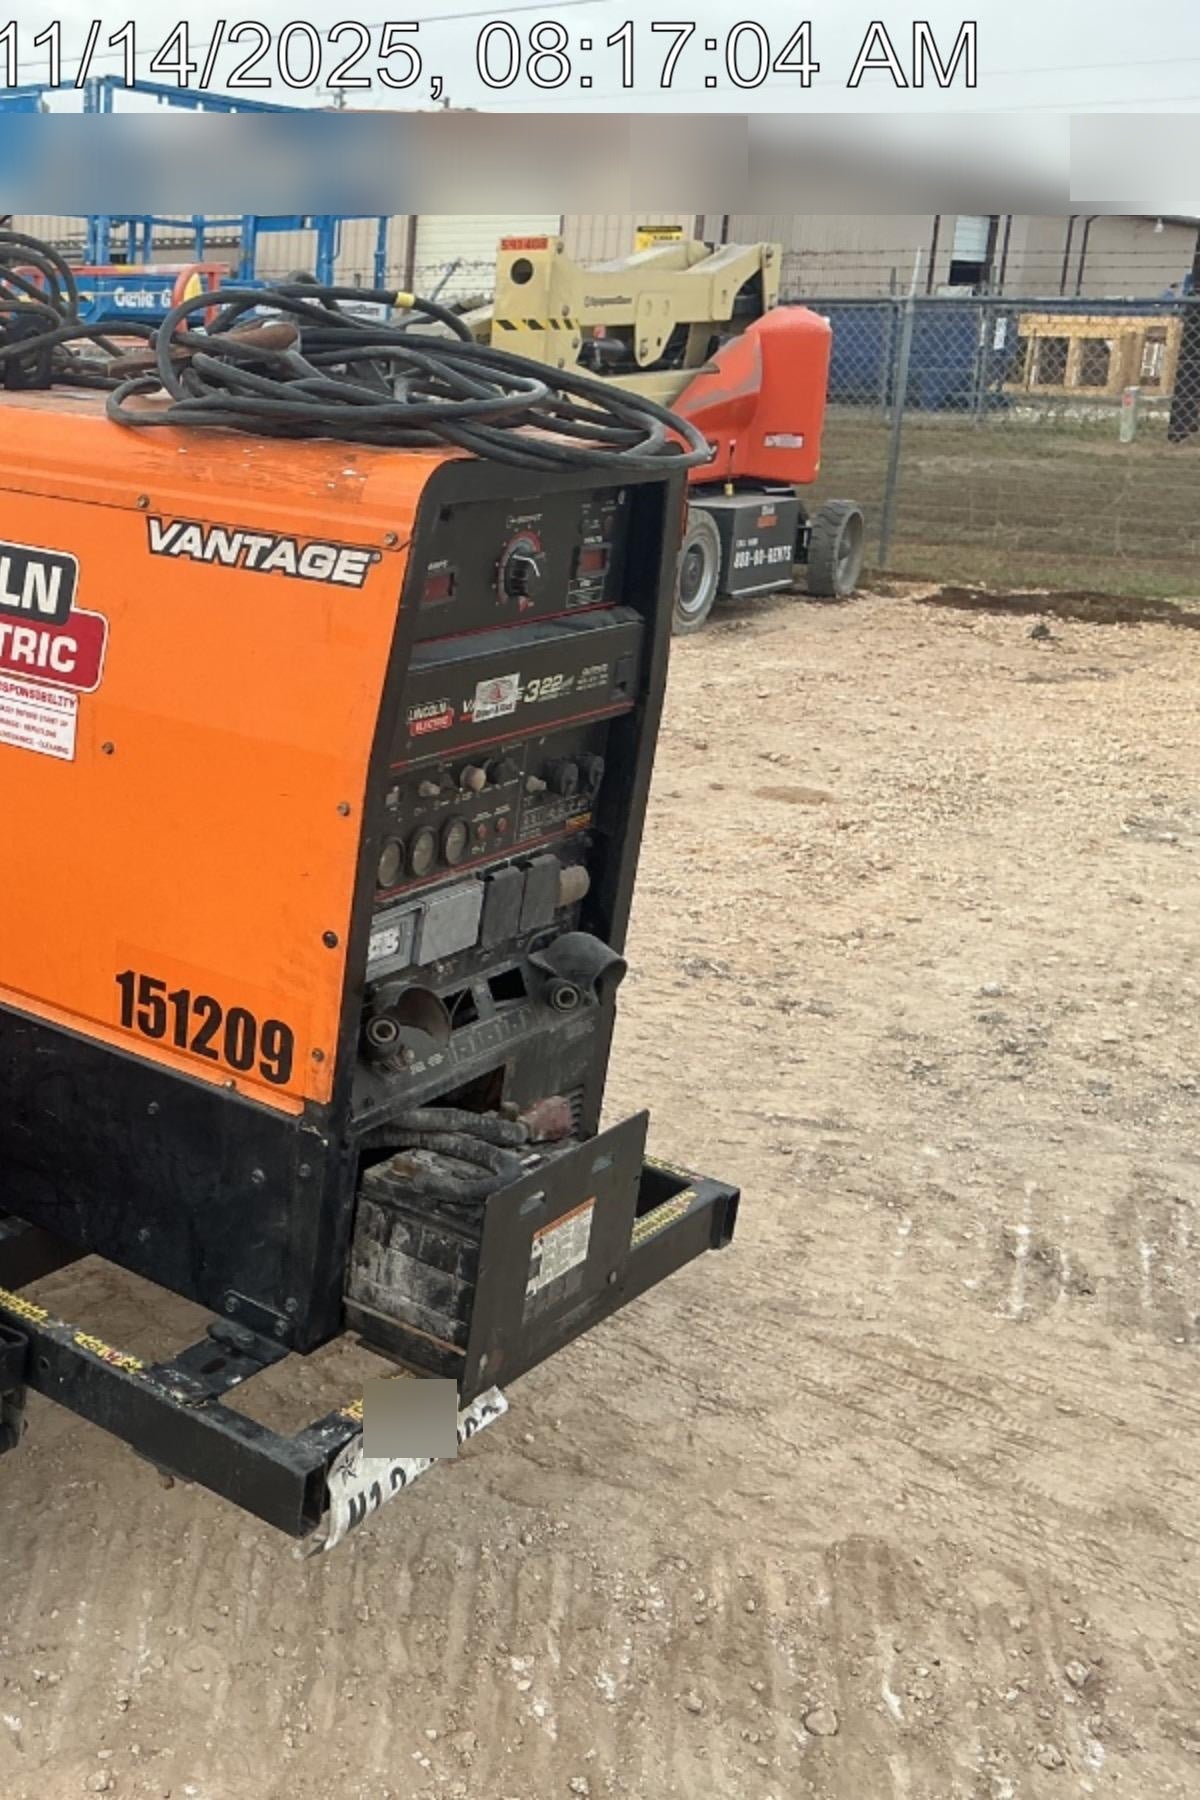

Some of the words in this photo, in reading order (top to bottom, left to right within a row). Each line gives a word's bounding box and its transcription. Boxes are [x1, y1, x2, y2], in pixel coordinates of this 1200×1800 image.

[113, 286, 156, 308] Genie
[150, 519, 371, 584] VANTAGE
[525, 674, 563, 702] 322
[115, 969, 294, 1085] 151209
